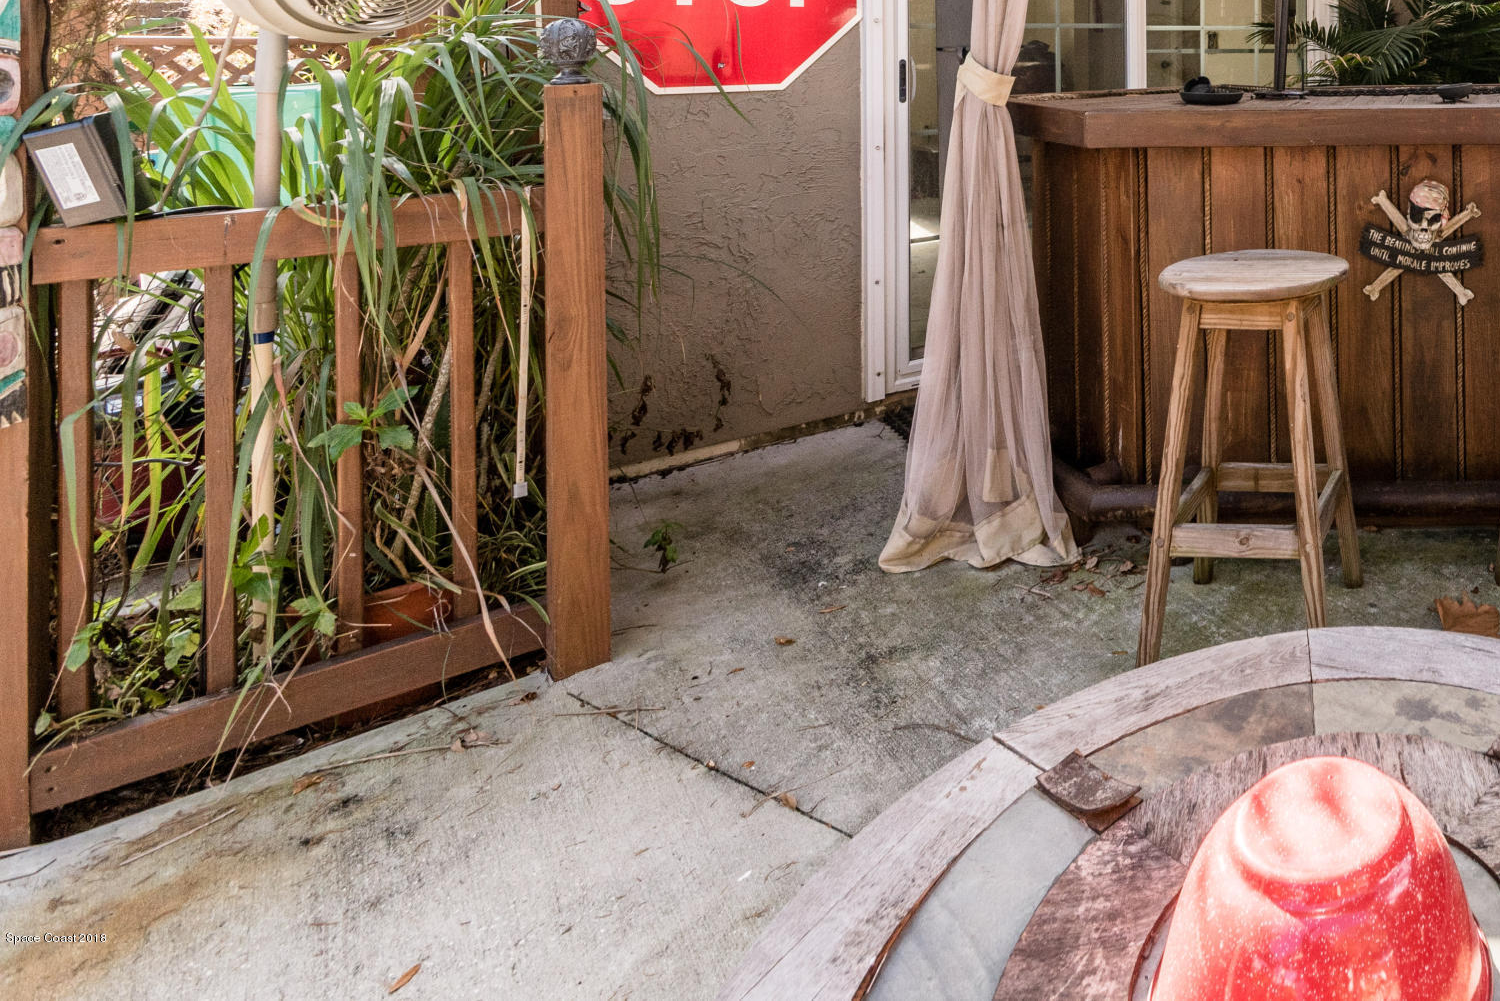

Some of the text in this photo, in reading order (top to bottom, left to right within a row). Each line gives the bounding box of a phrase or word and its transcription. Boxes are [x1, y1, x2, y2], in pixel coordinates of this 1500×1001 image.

[1369, 229, 1384, 244] THE
[1442, 241, 1477, 256] CONTINUE
[1370, 246, 1471, 272] UNTIL MORALE IMPROVES
